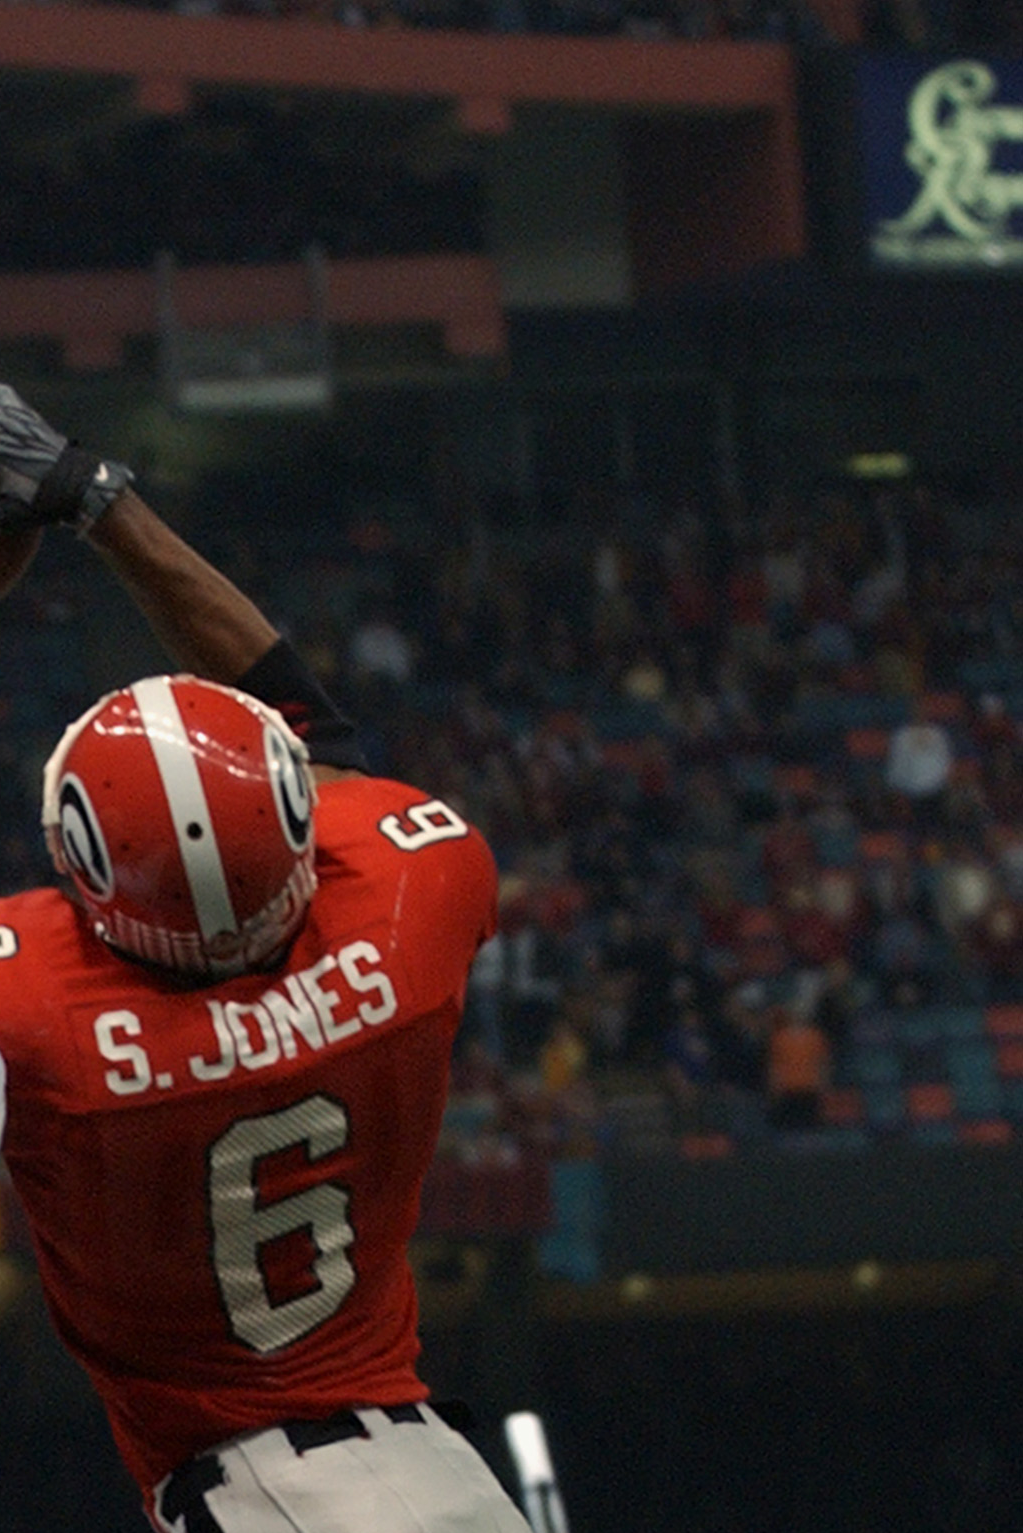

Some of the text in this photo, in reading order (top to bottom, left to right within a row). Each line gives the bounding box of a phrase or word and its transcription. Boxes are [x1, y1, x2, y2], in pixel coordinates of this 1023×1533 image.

[378, 798, 469, 852] 6
[93, 940, 398, 1096] S. JONES
[207, 1092, 356, 1356] 6
